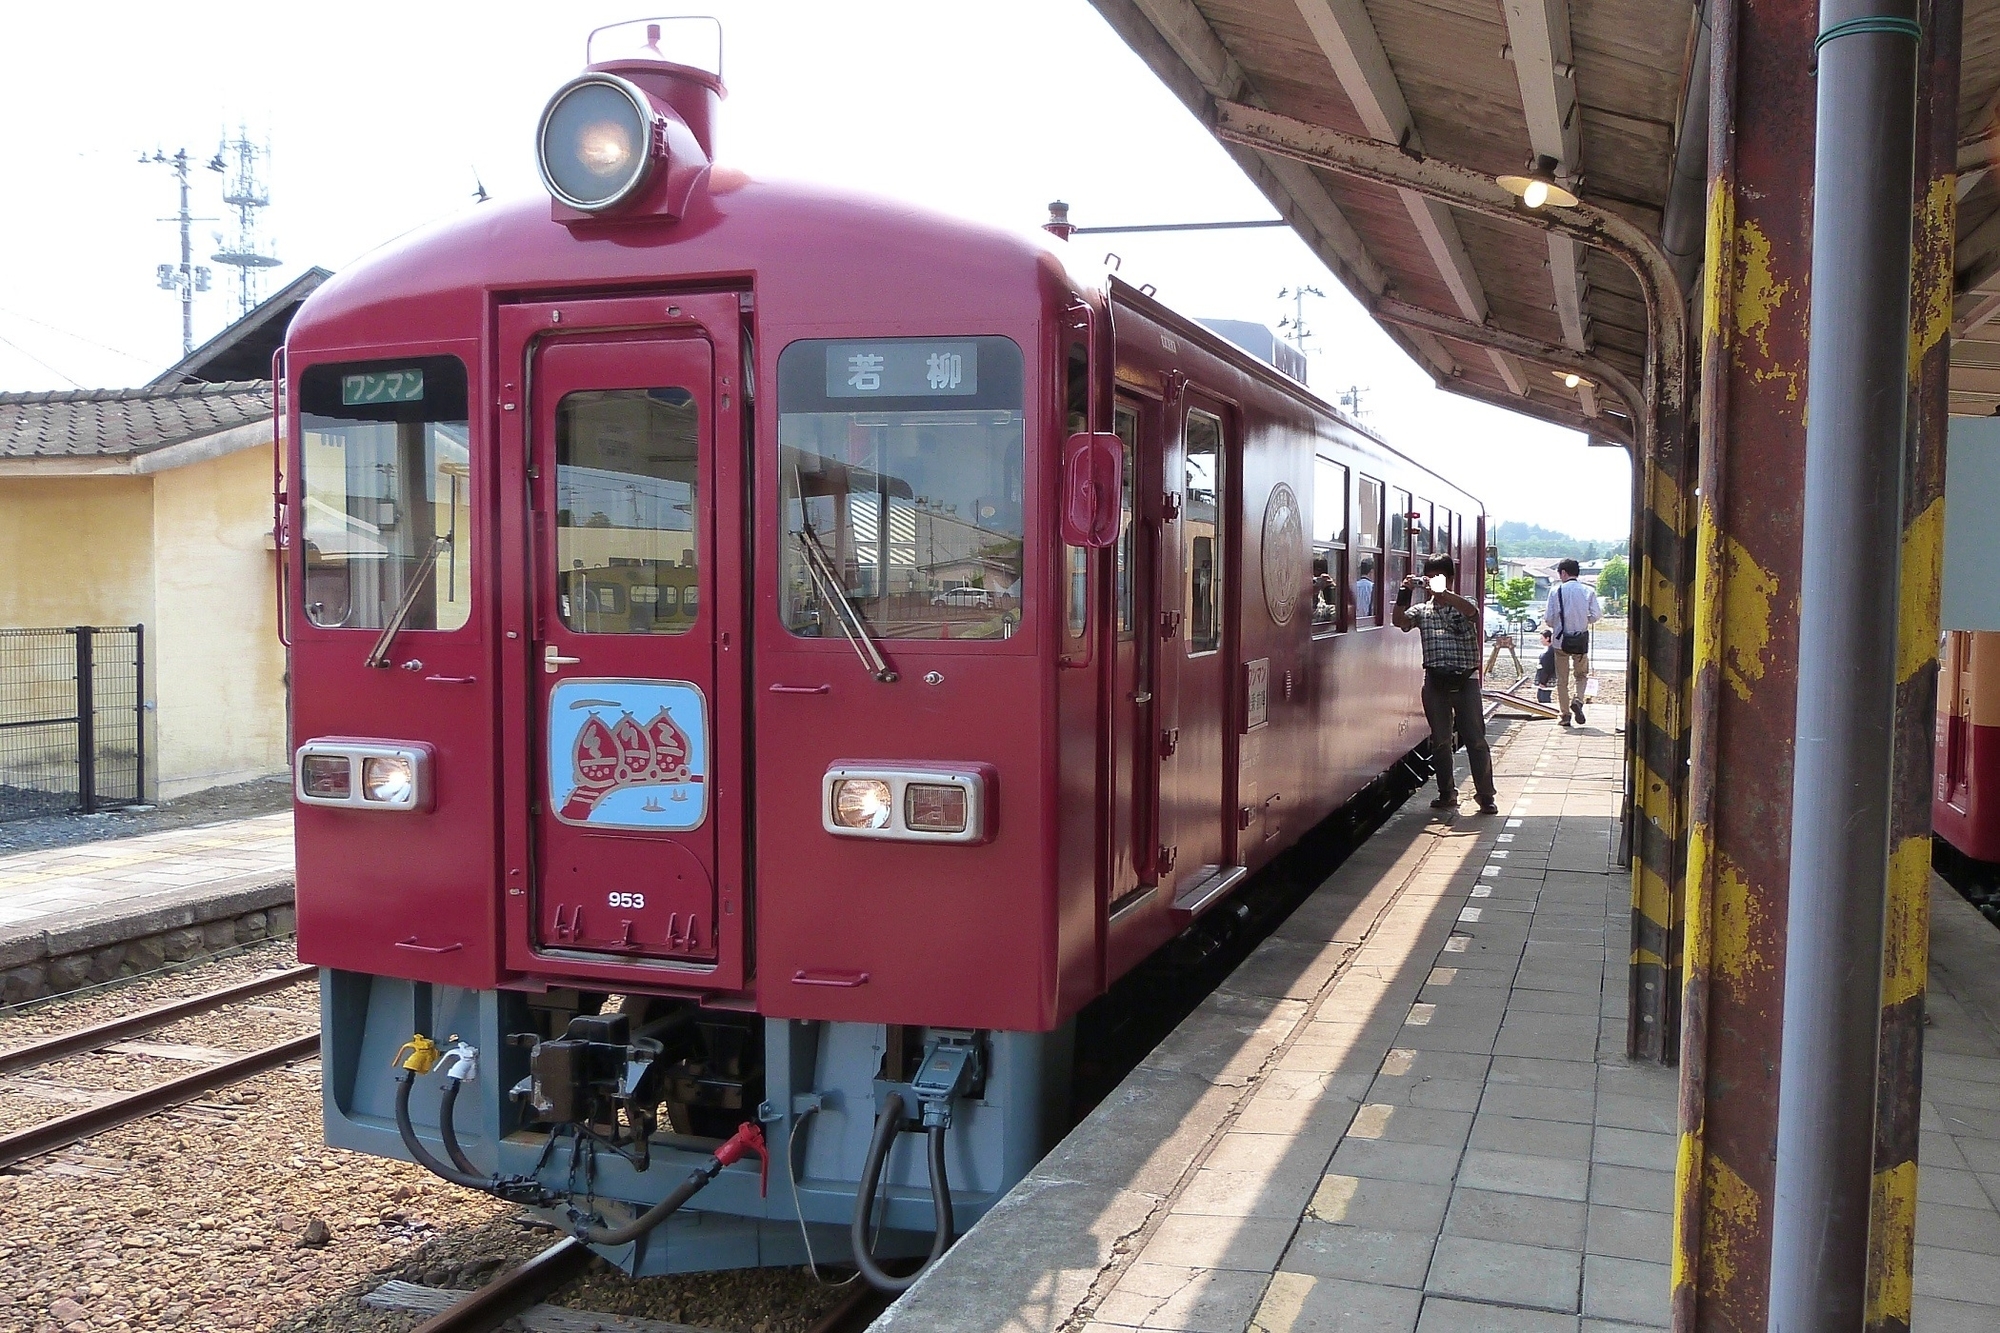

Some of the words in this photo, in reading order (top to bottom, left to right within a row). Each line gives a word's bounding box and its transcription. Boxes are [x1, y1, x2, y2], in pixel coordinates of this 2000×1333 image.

[848, 352, 962, 390] 若柳
[346, 372, 424, 400] ワンマン
[608, 891, 645, 909] 953
